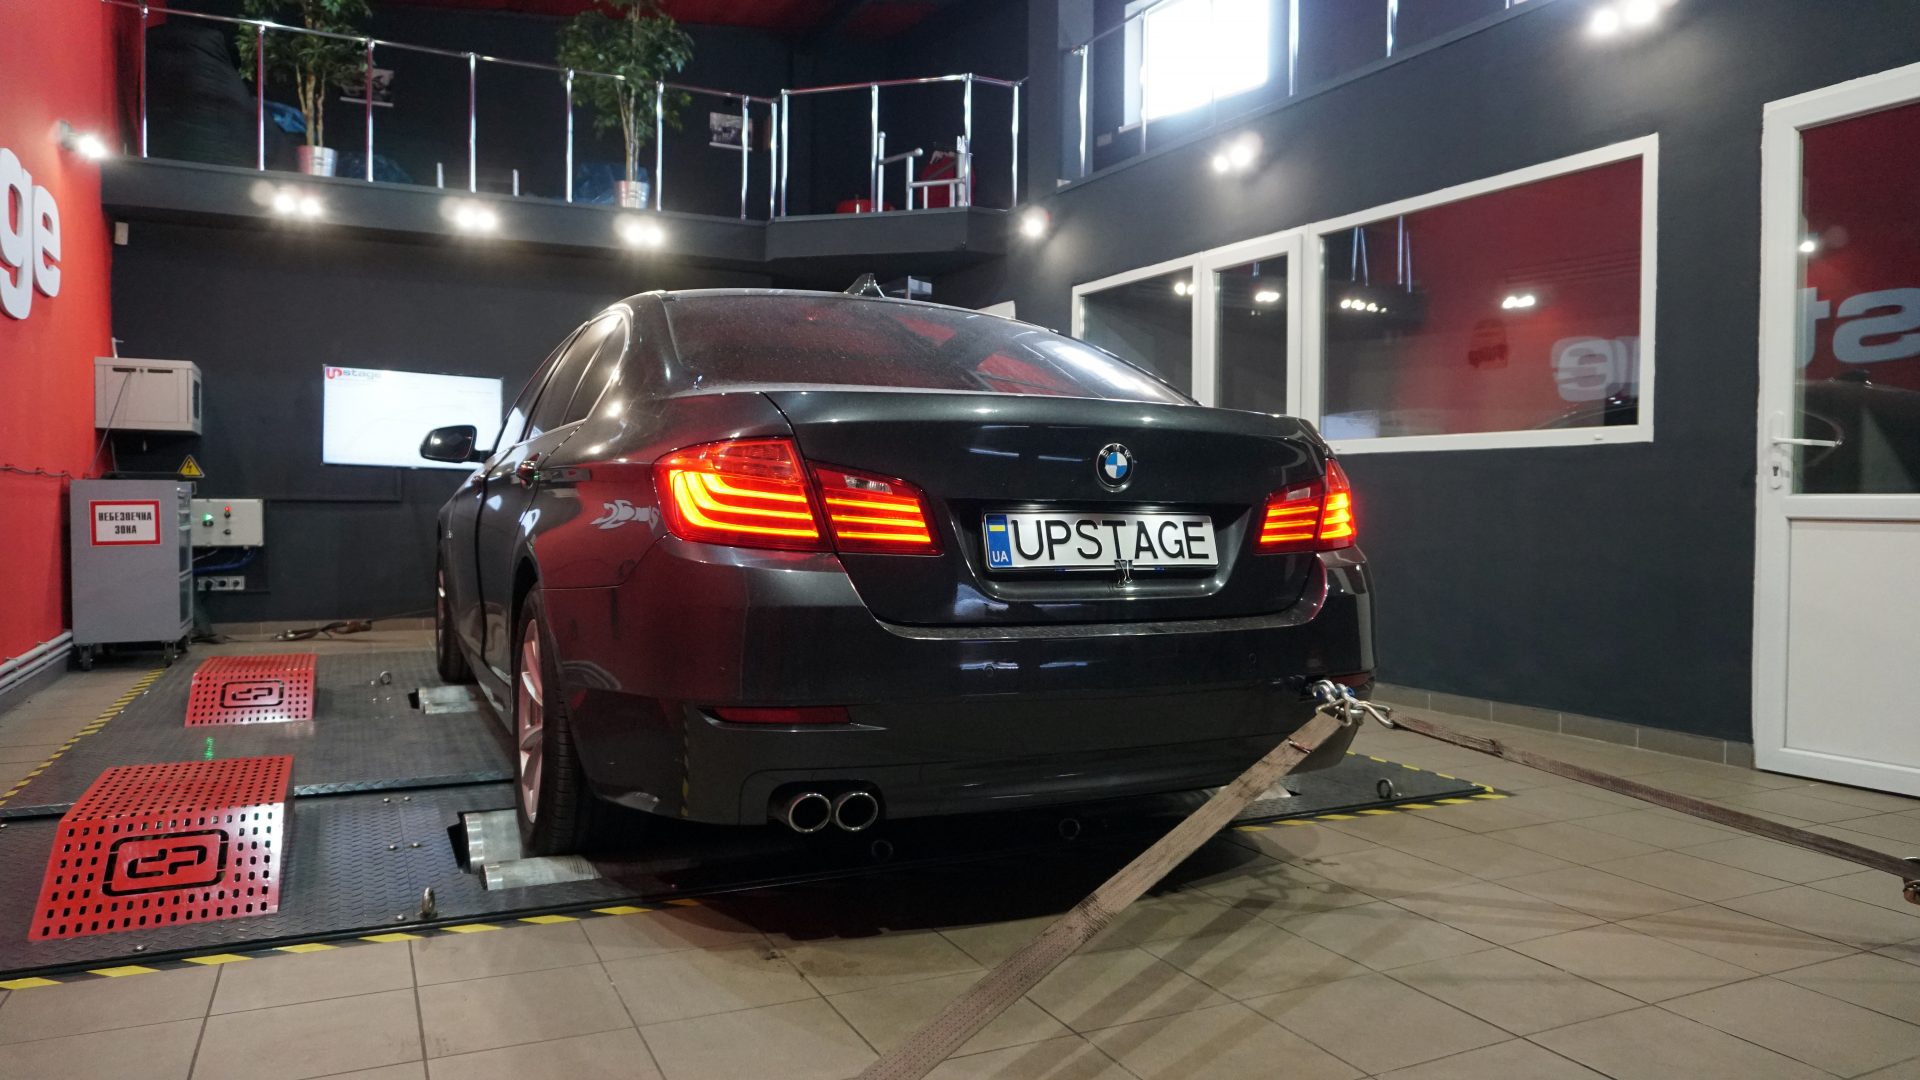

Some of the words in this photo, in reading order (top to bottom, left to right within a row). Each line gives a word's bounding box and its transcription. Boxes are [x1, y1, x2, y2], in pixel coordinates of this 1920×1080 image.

[114, 525, 137, 535] ЗОНА
[1011, 519, 1210, 561] UPSTAGE
[992, 550, 1009, 563] UA
